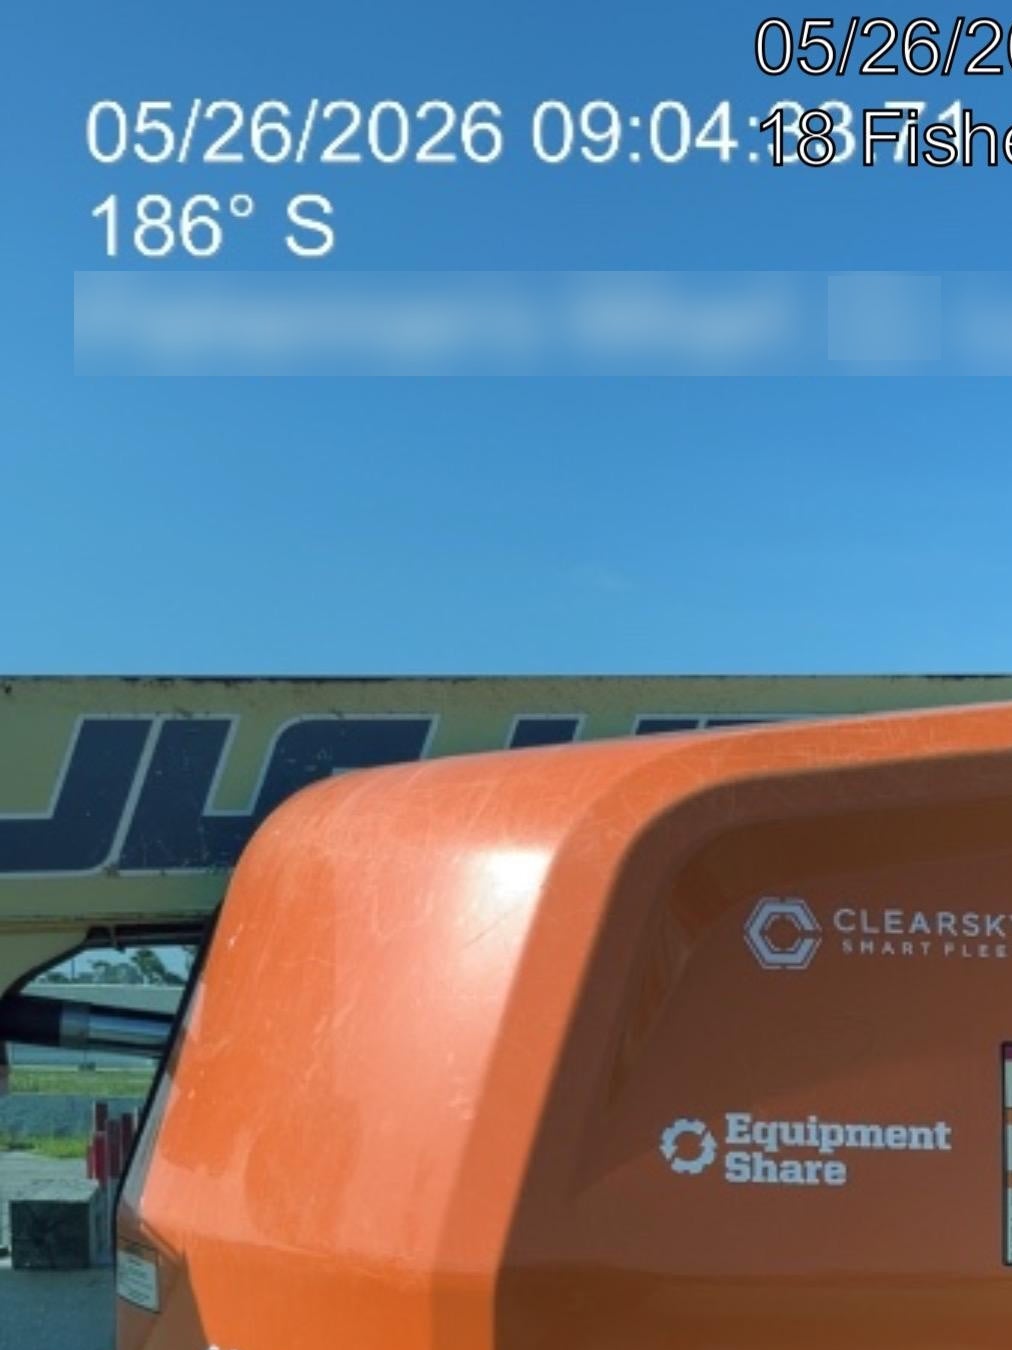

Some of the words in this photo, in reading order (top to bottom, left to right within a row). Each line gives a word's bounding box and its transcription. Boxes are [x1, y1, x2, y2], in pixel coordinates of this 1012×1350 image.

[842, 940, 931, 957] SMART
[724, 1111, 952, 1153] Equipment
[724, 1151, 847, 1185] Share
